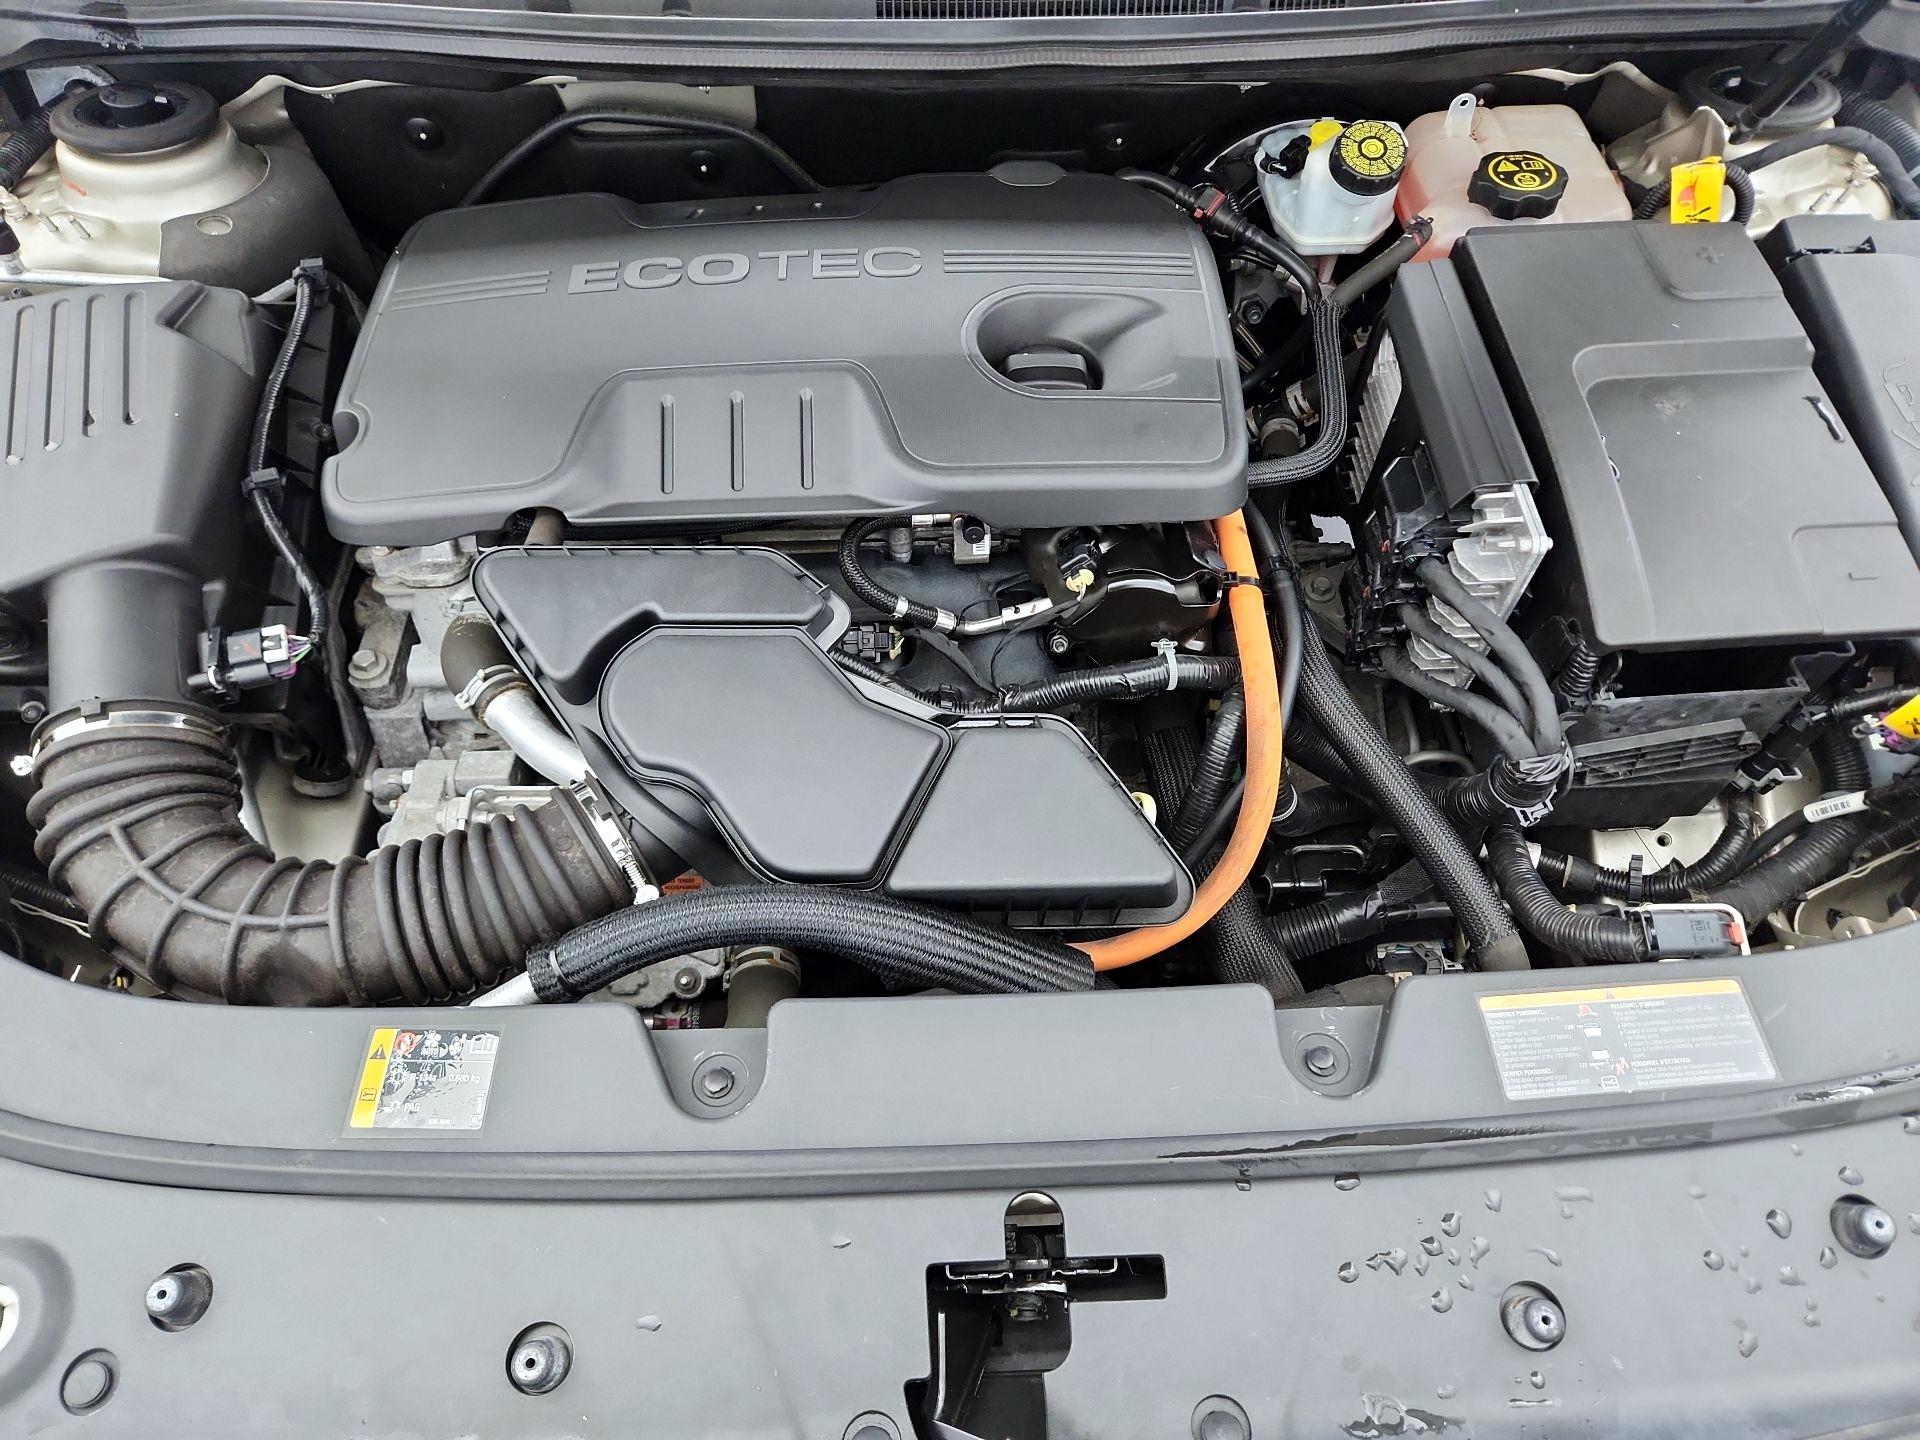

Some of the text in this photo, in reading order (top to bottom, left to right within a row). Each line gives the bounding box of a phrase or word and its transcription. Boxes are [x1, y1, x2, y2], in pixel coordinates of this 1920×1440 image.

[567, 246, 923, 295] ECOTEC
[410, 1073, 437, 1082] R-134a
[403, 1102, 421, 1112] PAG
